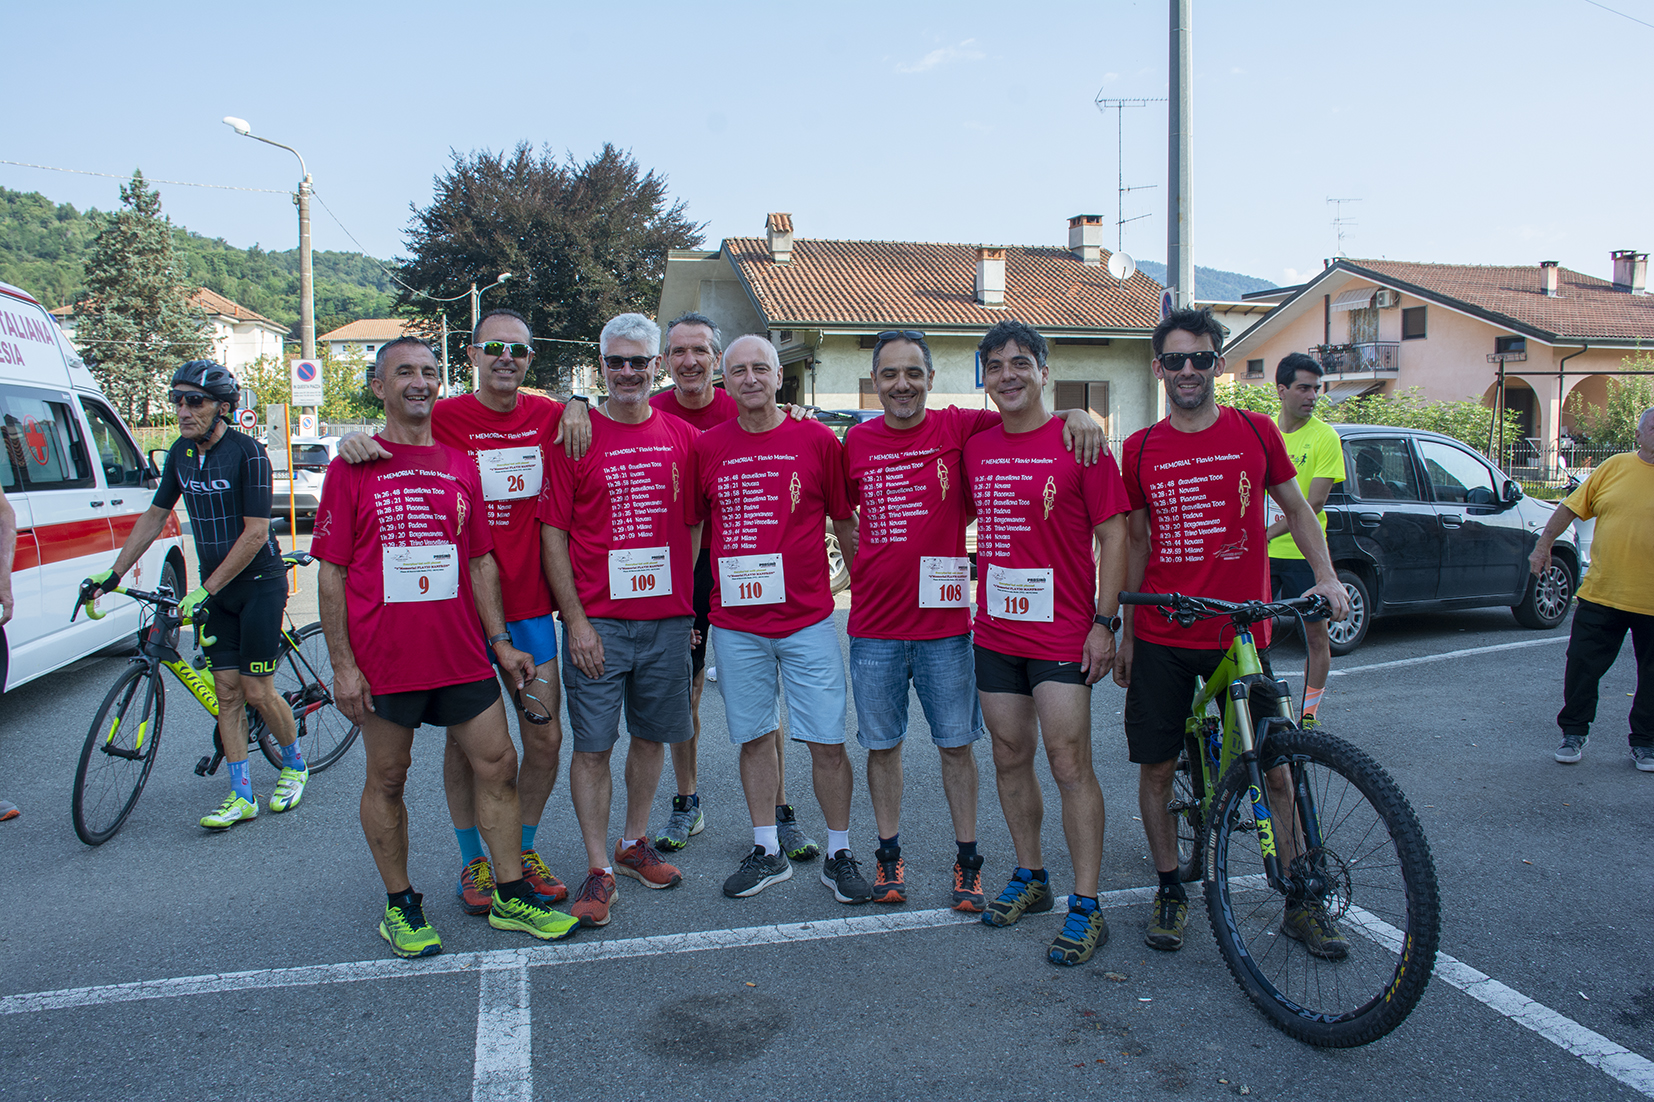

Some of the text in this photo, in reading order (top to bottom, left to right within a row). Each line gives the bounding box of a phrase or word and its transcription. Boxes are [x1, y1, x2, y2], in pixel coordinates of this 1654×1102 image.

[609, 448, 636, 456] MEMORIAL
[728, 457, 754, 465] MEMORIAL
[1160, 459, 1191, 470] MEMORIAL
[177, 467, 231, 492] VELO
[383, 470, 415, 479] MEMORIAL
[507, 474, 524, 492] 26
[1178, 476, 1208, 485] Gravellona
[888, 502, 922, 511] Borgomanero
[1181, 503, 1211, 511] Gravellona
[1184, 519, 1220, 528] Borgomanero
[1198, 527, 1226, 535] Vercellese
[419, 576, 429, 594] 9
[631, 574, 655, 591] 109
[739, 582, 762, 599] 110
[940, 584, 961, 601] 108
[1005, 596, 1029, 614] 119
[1256, 818, 1277, 858] FOX
